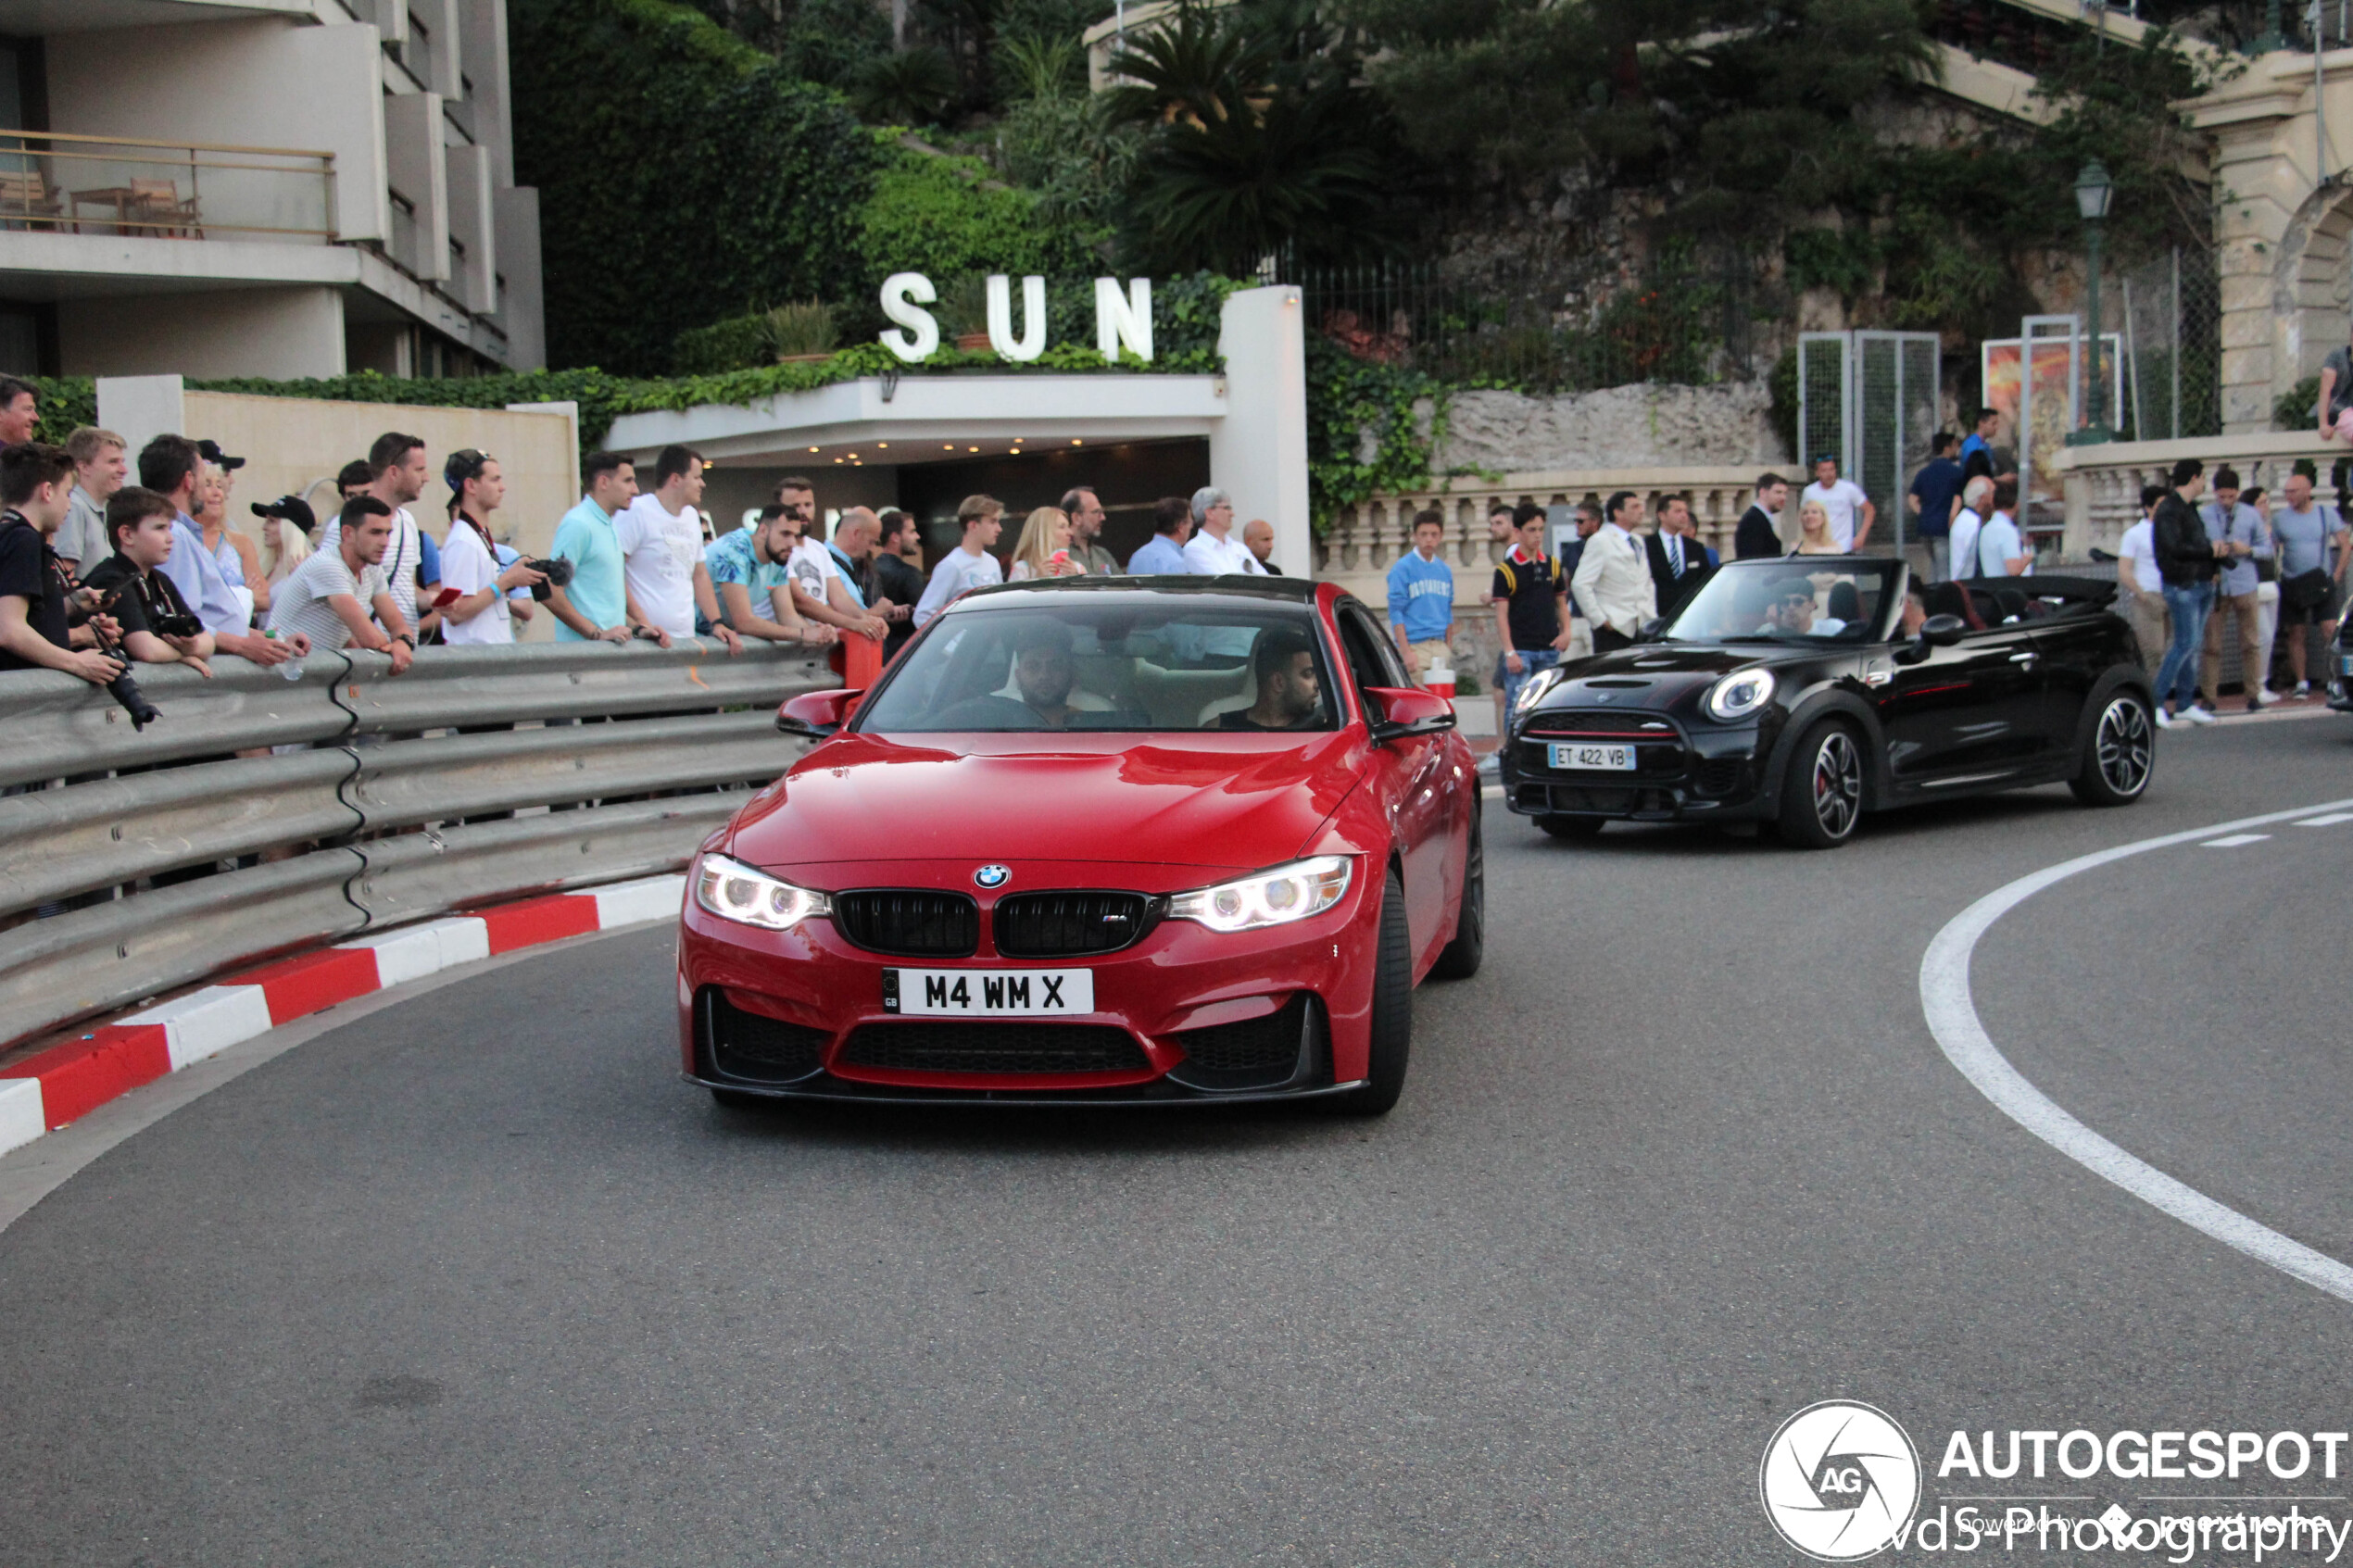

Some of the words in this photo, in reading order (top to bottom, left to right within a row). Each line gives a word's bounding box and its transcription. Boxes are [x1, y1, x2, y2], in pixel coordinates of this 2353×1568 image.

[879, 272, 1153, 363] SUN
[885, 997, 898, 1007] GB
[925, 975, 971, 1009] M4
[983, 976, 1030, 1009] WM
[1042, 975, 1064, 1008] X
